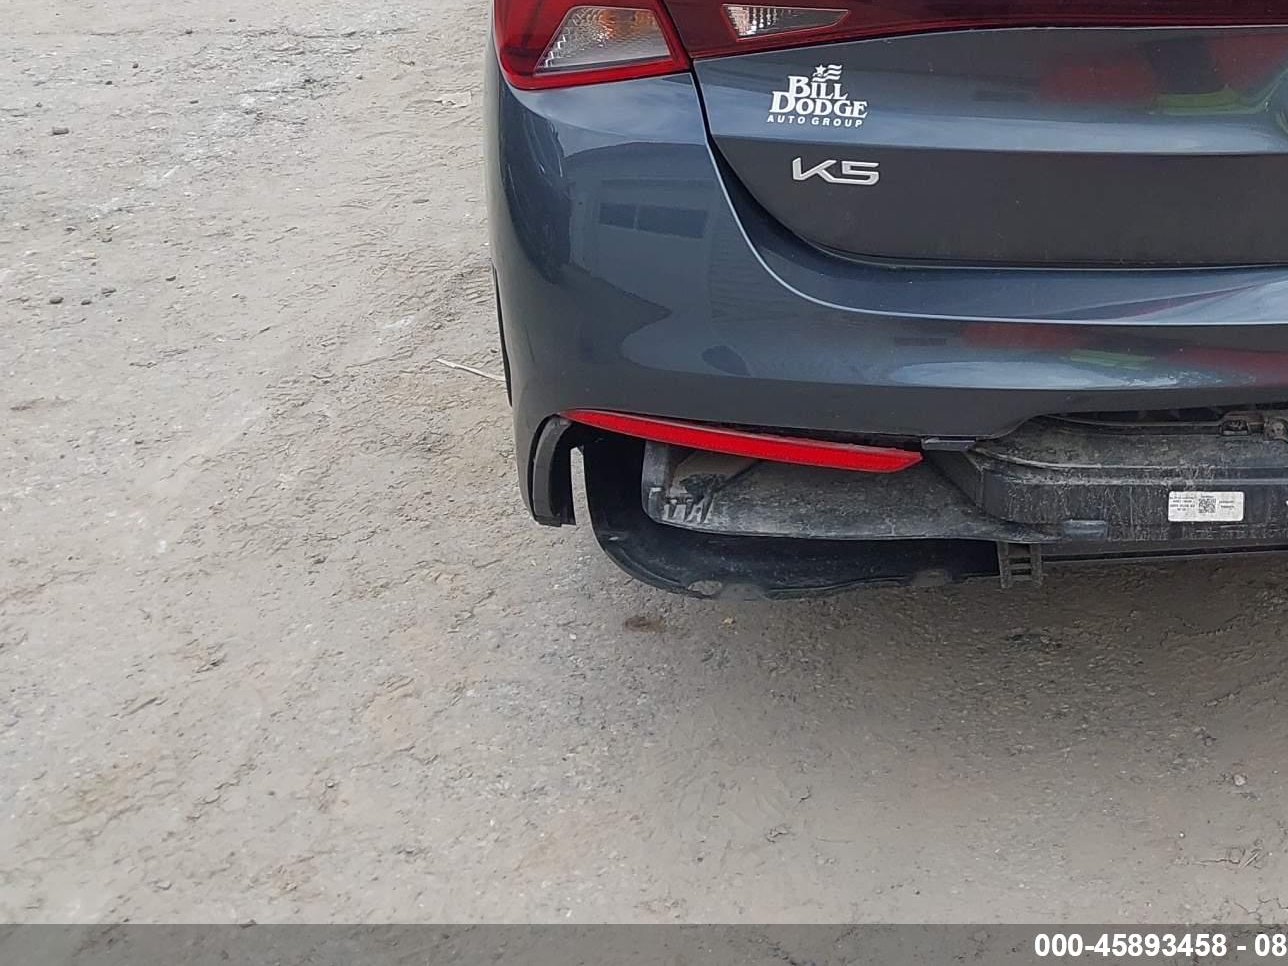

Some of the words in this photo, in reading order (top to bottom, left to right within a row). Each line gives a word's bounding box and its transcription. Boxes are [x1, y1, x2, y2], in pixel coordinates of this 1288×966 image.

[787, 75, 849, 100] BILL
[768, 90, 868, 119] DODGE
[766, 115, 806, 125] AUTO
[811, 116, 863, 128] GROUP
[792, 157, 880, 186] K5
